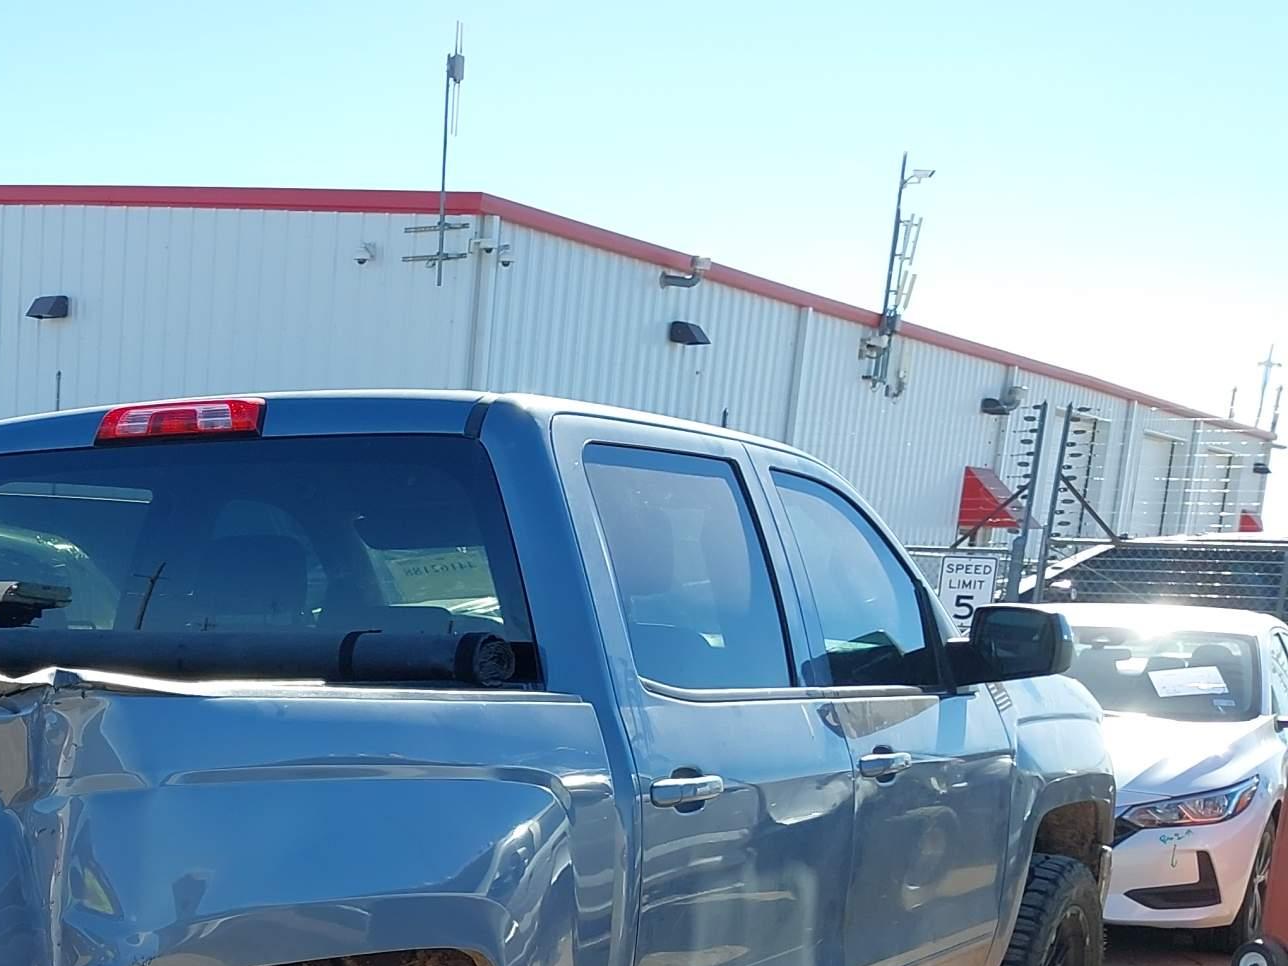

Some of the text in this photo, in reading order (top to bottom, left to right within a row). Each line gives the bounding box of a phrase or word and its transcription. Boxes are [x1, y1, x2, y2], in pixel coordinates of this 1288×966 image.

[945, 563, 993, 575] SPEED
[948, 579, 985, 590] LIMIT
[952, 594, 975, 620] 5
